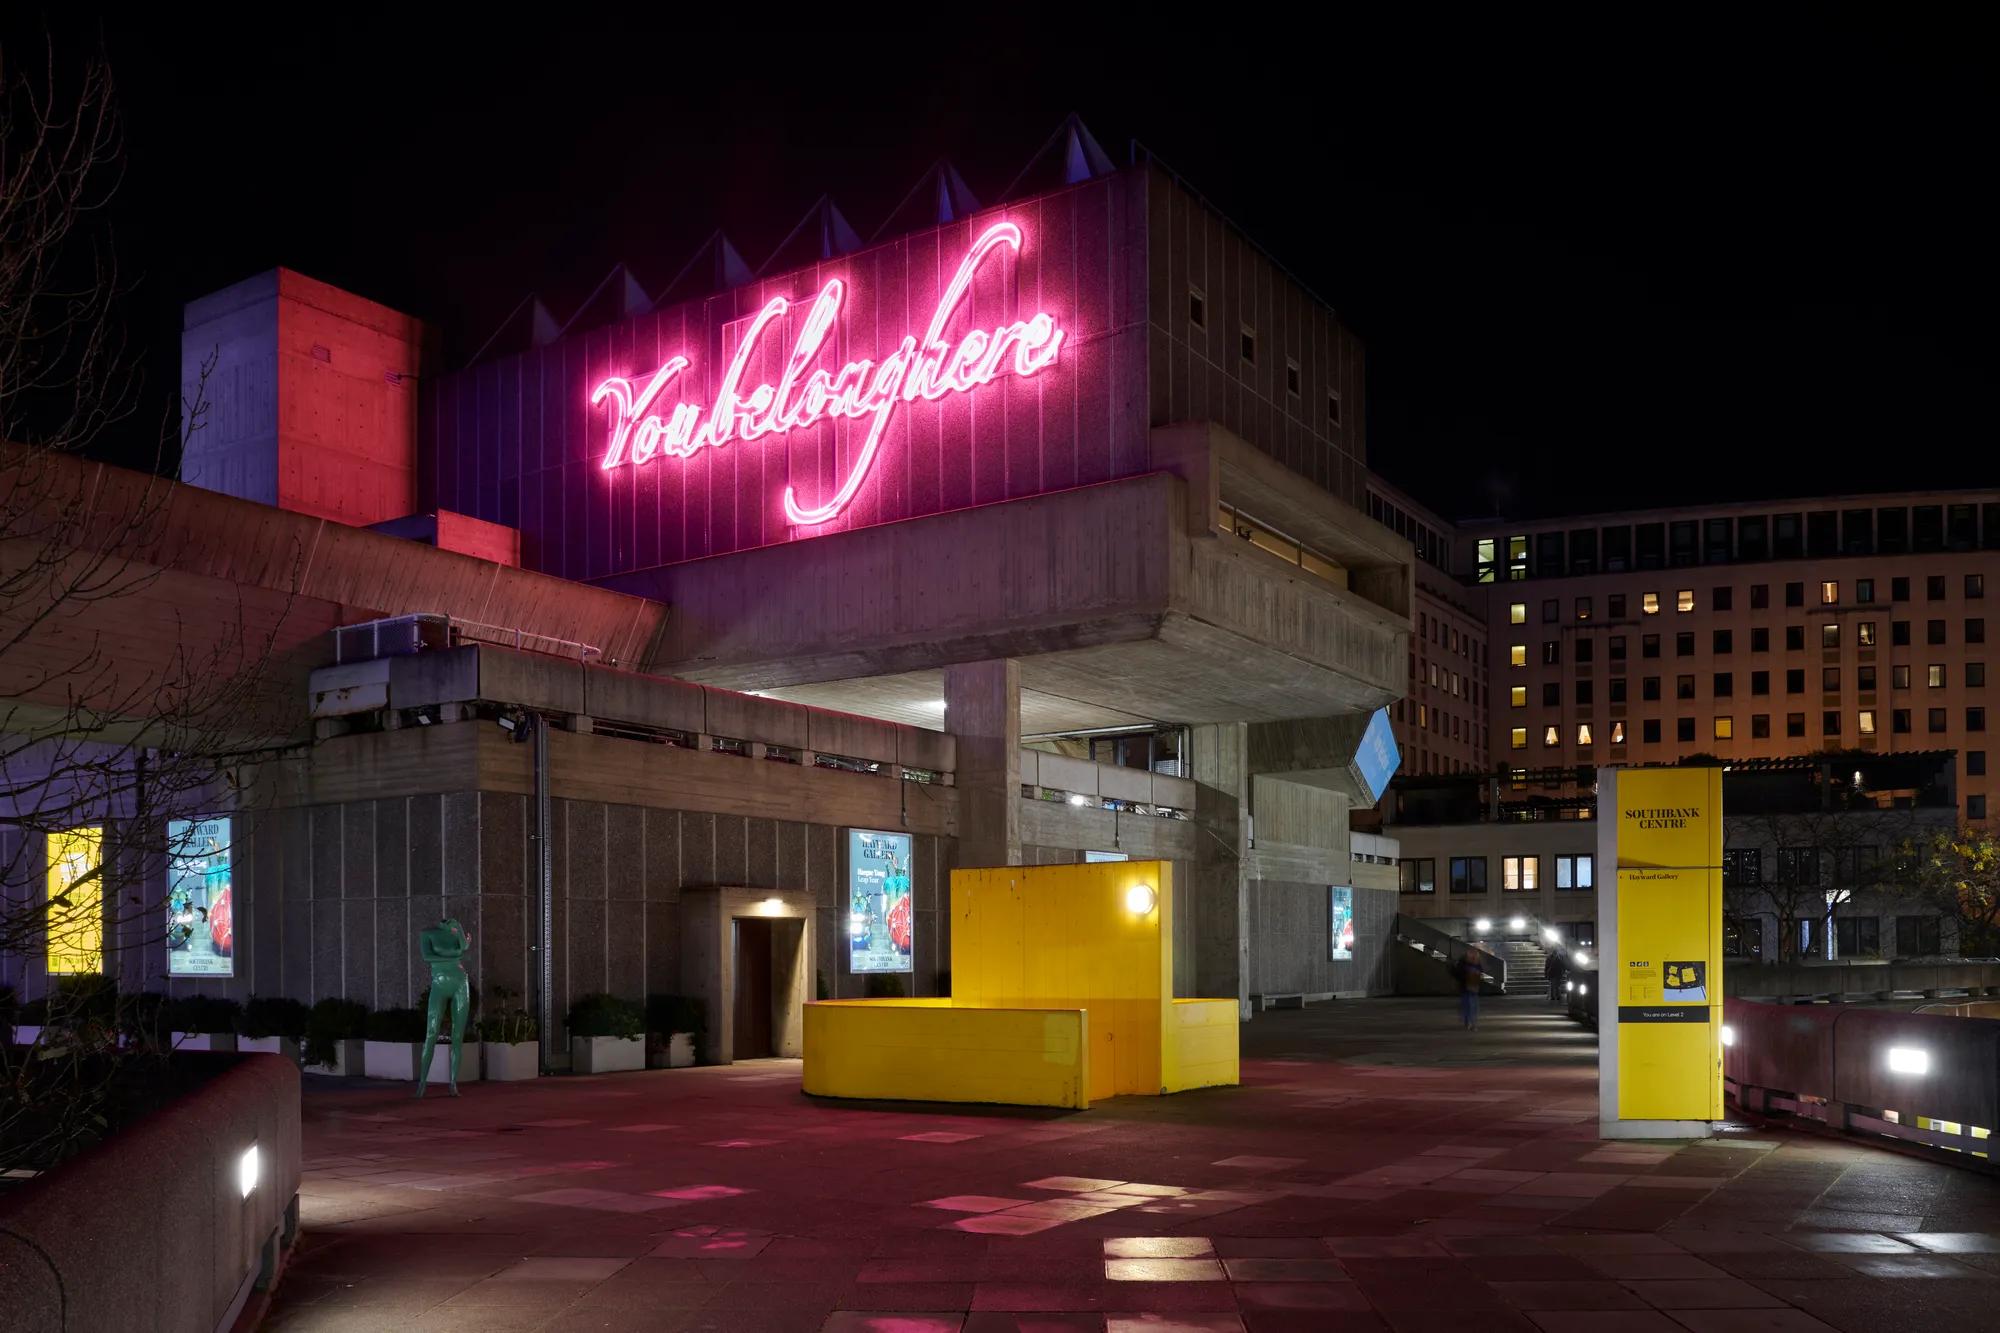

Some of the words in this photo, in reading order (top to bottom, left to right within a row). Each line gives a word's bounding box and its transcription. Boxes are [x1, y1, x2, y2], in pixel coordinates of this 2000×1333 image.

[592, 355, 704, 471] You
[702, 277, 914, 526] belong
[908, 220, 1067, 402] here
[1625, 808, 1700, 819] SOUTHBANK
[1639, 819, 1687, 829] CENTRE
